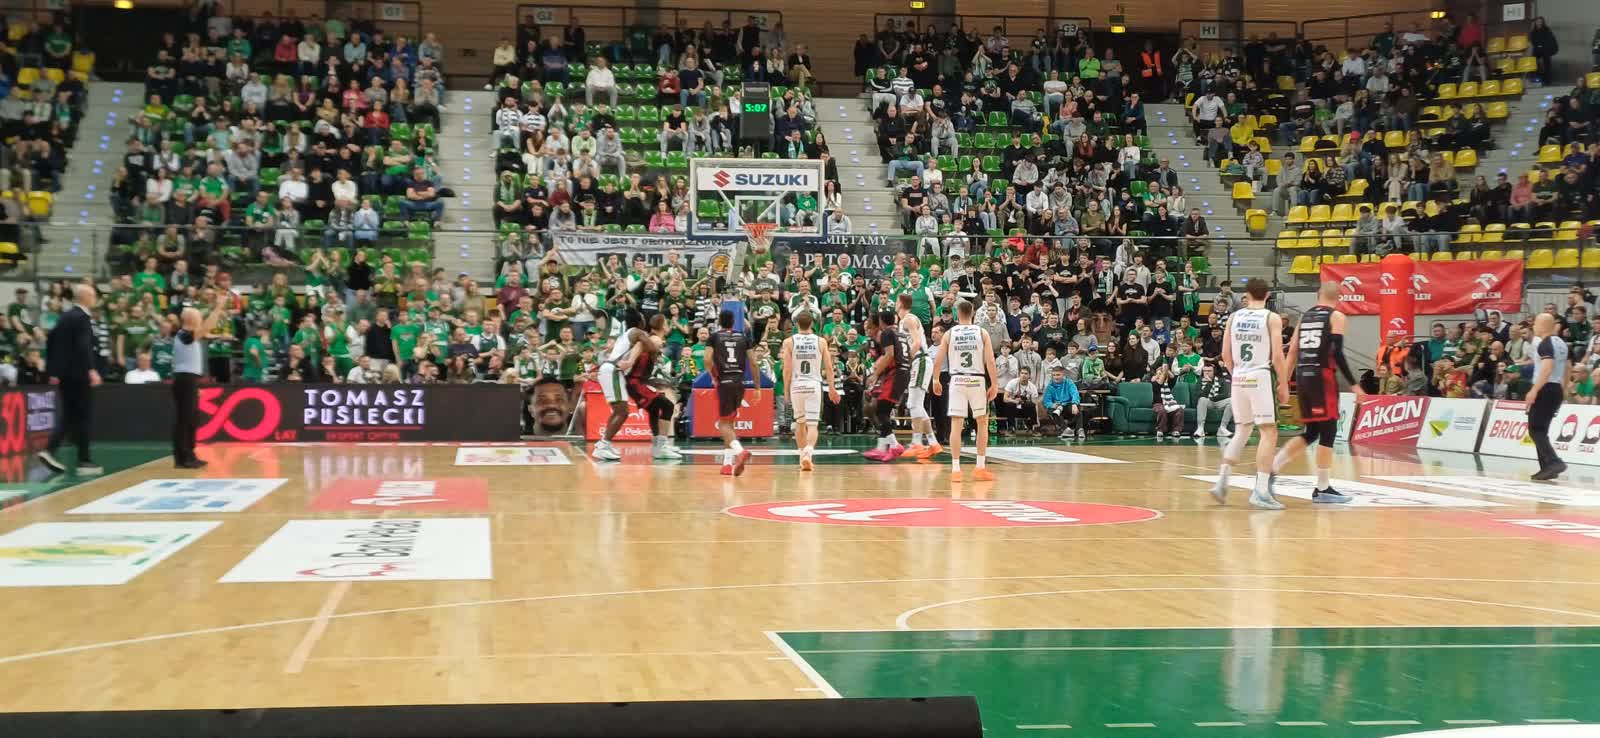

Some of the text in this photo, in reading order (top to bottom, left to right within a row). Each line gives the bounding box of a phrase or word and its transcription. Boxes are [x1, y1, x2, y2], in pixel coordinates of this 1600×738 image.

[1202, 26, 1216, 35] H1
[744, 103, 768, 112] 5:07
[734, 173, 808, 186] SUZUKI
[826, 253, 896, 269] TOMAS
[1472, 291, 1502, 300] ORLEN
[1299, 329, 1323, 348] 25
[726, 347, 737, 362] 1
[960, 351, 973, 368] 3
[1240, 343, 1253, 362] 6
[800, 360, 811, 375] 0
[304, 389, 424, 406] TOMASZ
[195, 388, 281, 441] 50
[1357, 397, 1424, 430] AiKON
[275, 431, 297, 440] LAT
[1489, 420, 1529, 440] BRICO
[952, 501, 1081, 523] ORLEN
